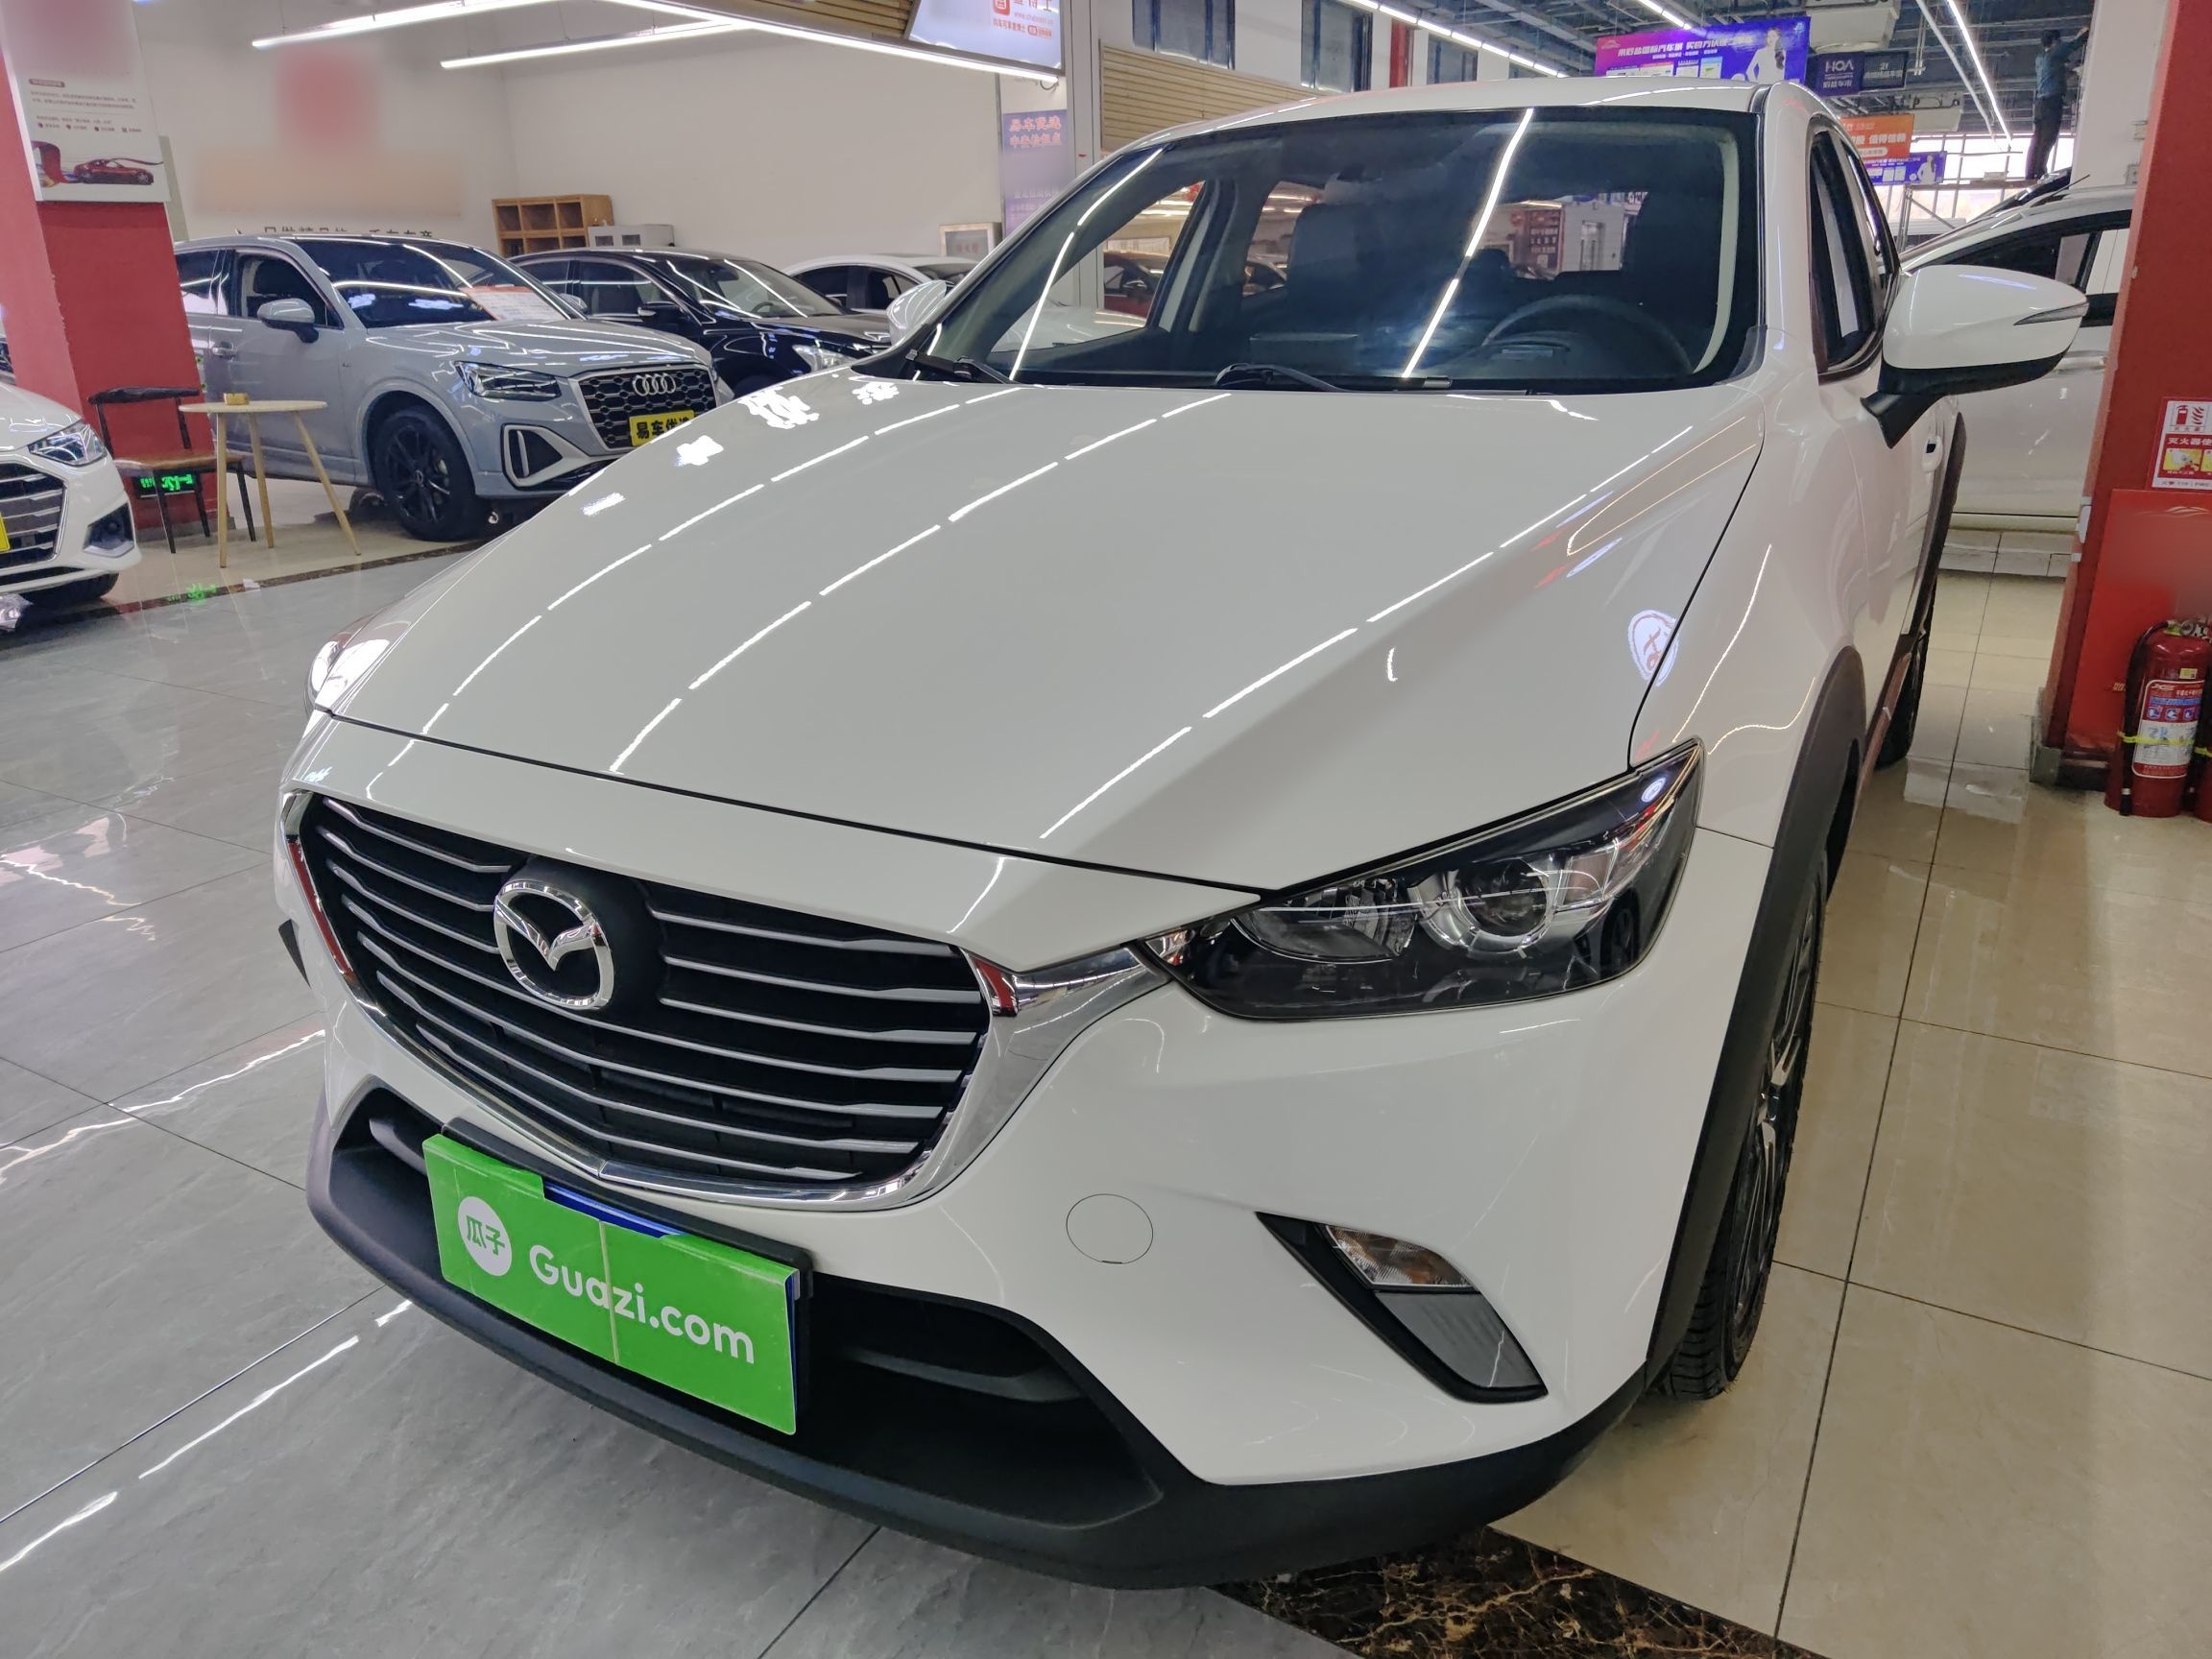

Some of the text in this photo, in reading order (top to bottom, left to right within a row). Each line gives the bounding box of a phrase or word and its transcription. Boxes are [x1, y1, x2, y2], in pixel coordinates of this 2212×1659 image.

[637, 416, 689, 439] 易车优
[466, 1214, 506, 1256] 瓜子
[529, 1244, 755, 1364] Guazi.com
